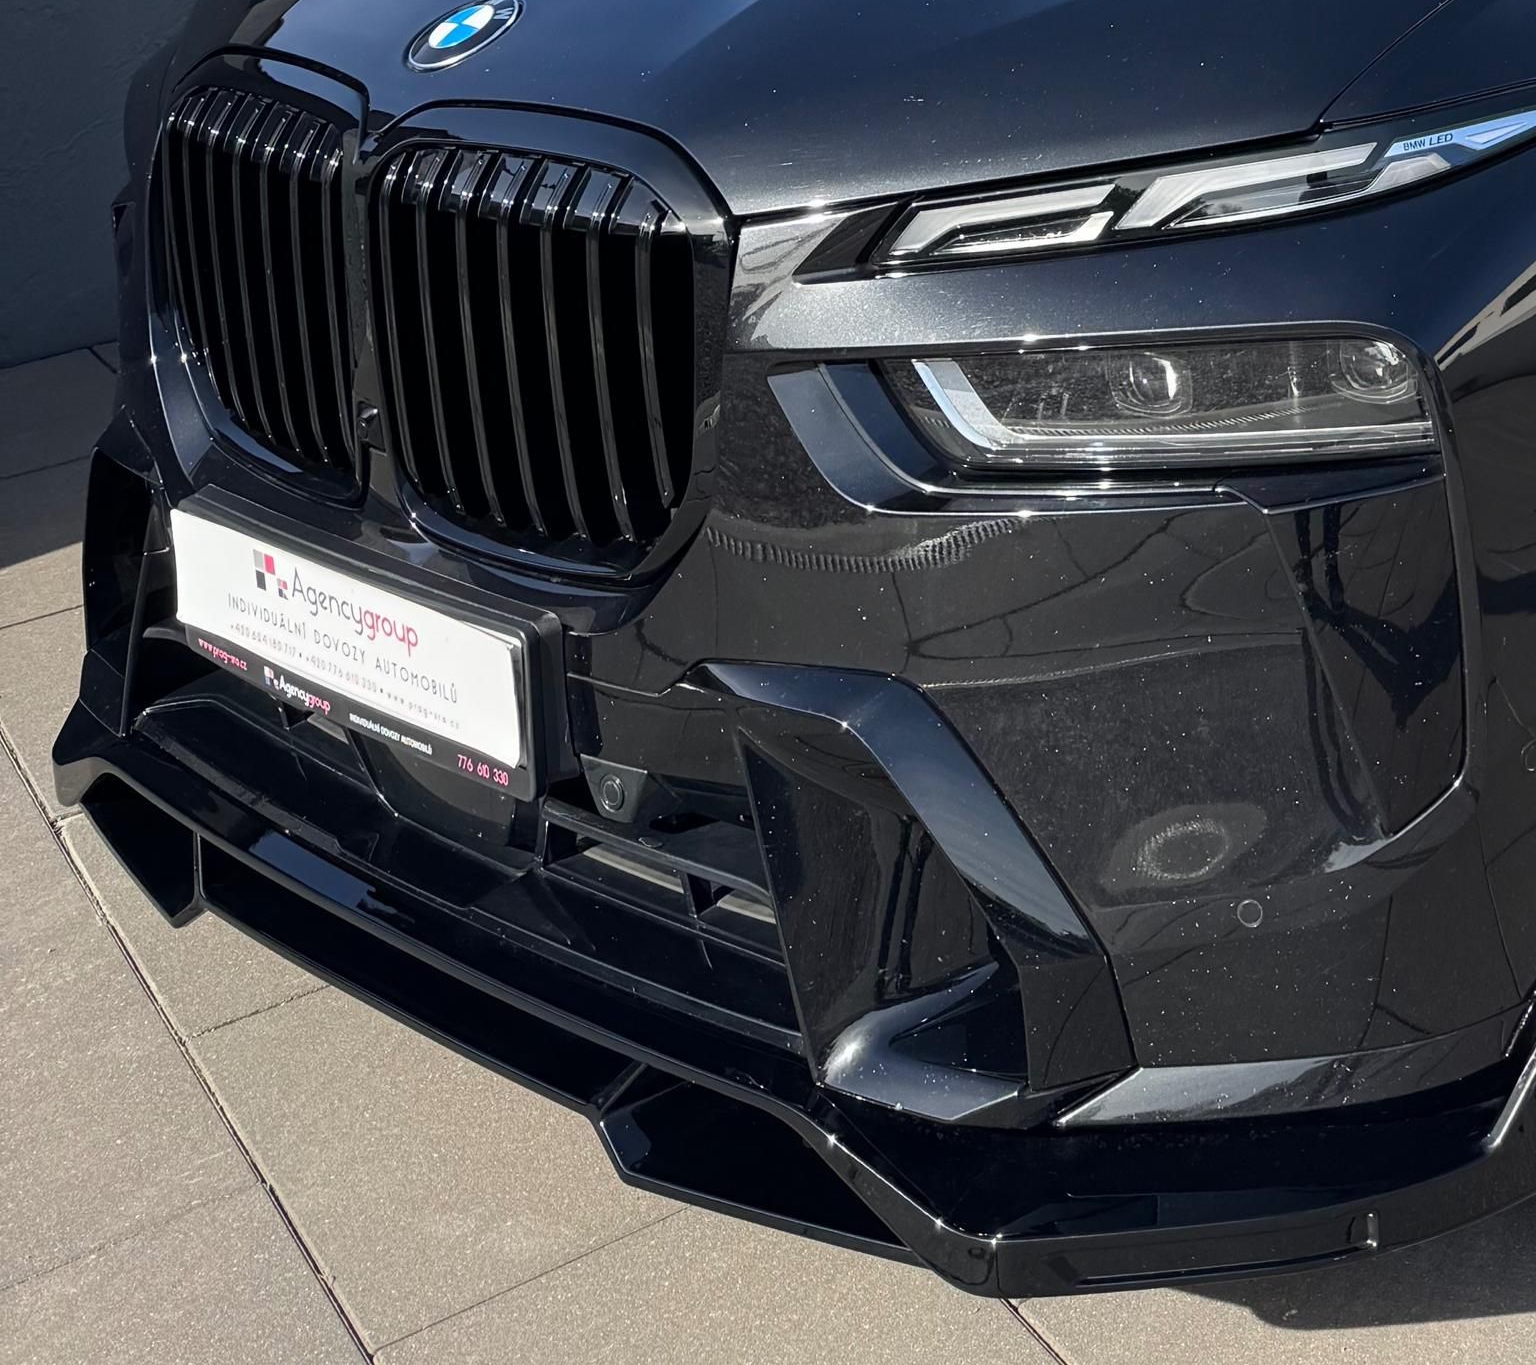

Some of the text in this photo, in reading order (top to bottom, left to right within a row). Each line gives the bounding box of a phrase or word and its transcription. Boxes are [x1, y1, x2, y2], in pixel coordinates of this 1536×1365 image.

[1403, 132, 1453, 151] BMW LED
[291, 566, 419, 658] Agencygroup
[228, 592, 458, 703] INDIVIDUÁLNÍ DOVOZY AUTOMOBILŮ
[279, 675, 331, 715] Agencygroup
[457, 754, 509, 786] 776 610 330
